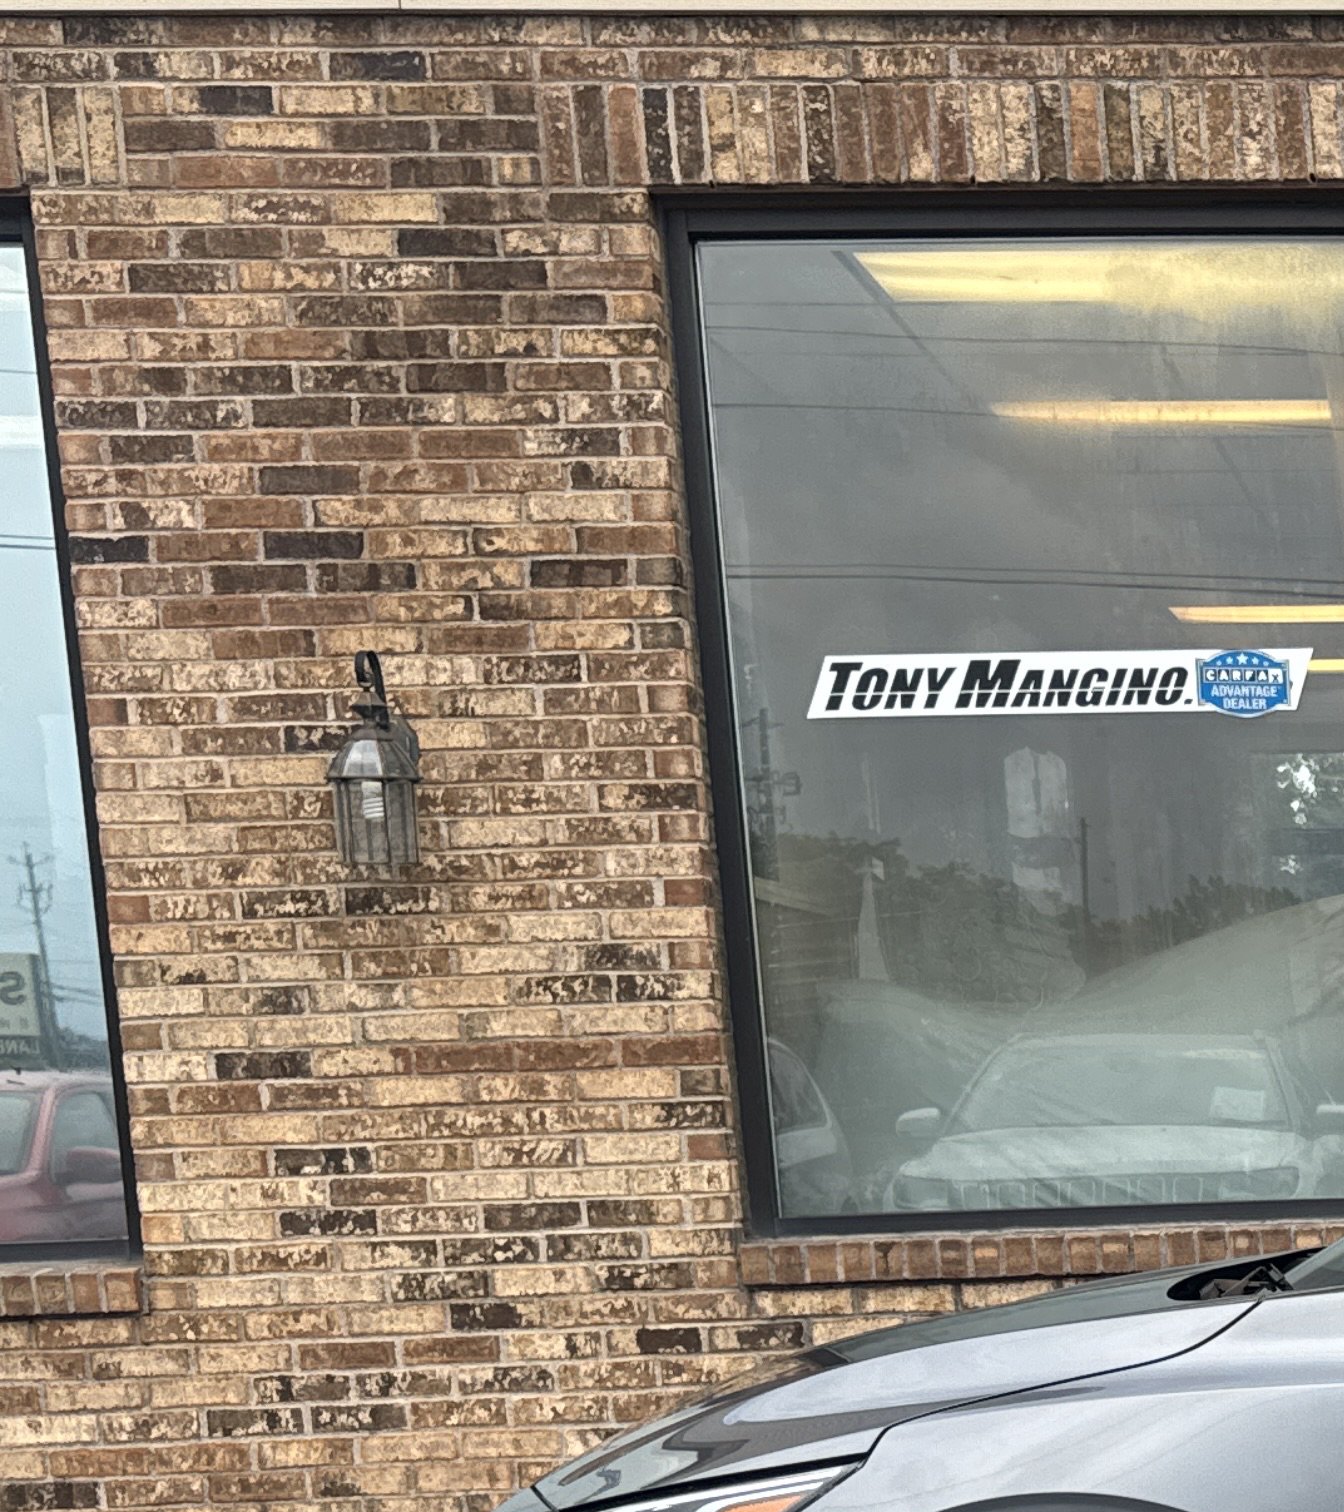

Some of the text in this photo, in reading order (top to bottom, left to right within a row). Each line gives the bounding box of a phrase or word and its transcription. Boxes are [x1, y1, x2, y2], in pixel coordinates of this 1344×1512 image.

[1203, 667, 1284, 684] CARFAX
[824, 661, 958, 711] TONY
[1211, 684, 1279, 698] ADVANTAGE
[1223, 698, 1267, 710] DEALER
